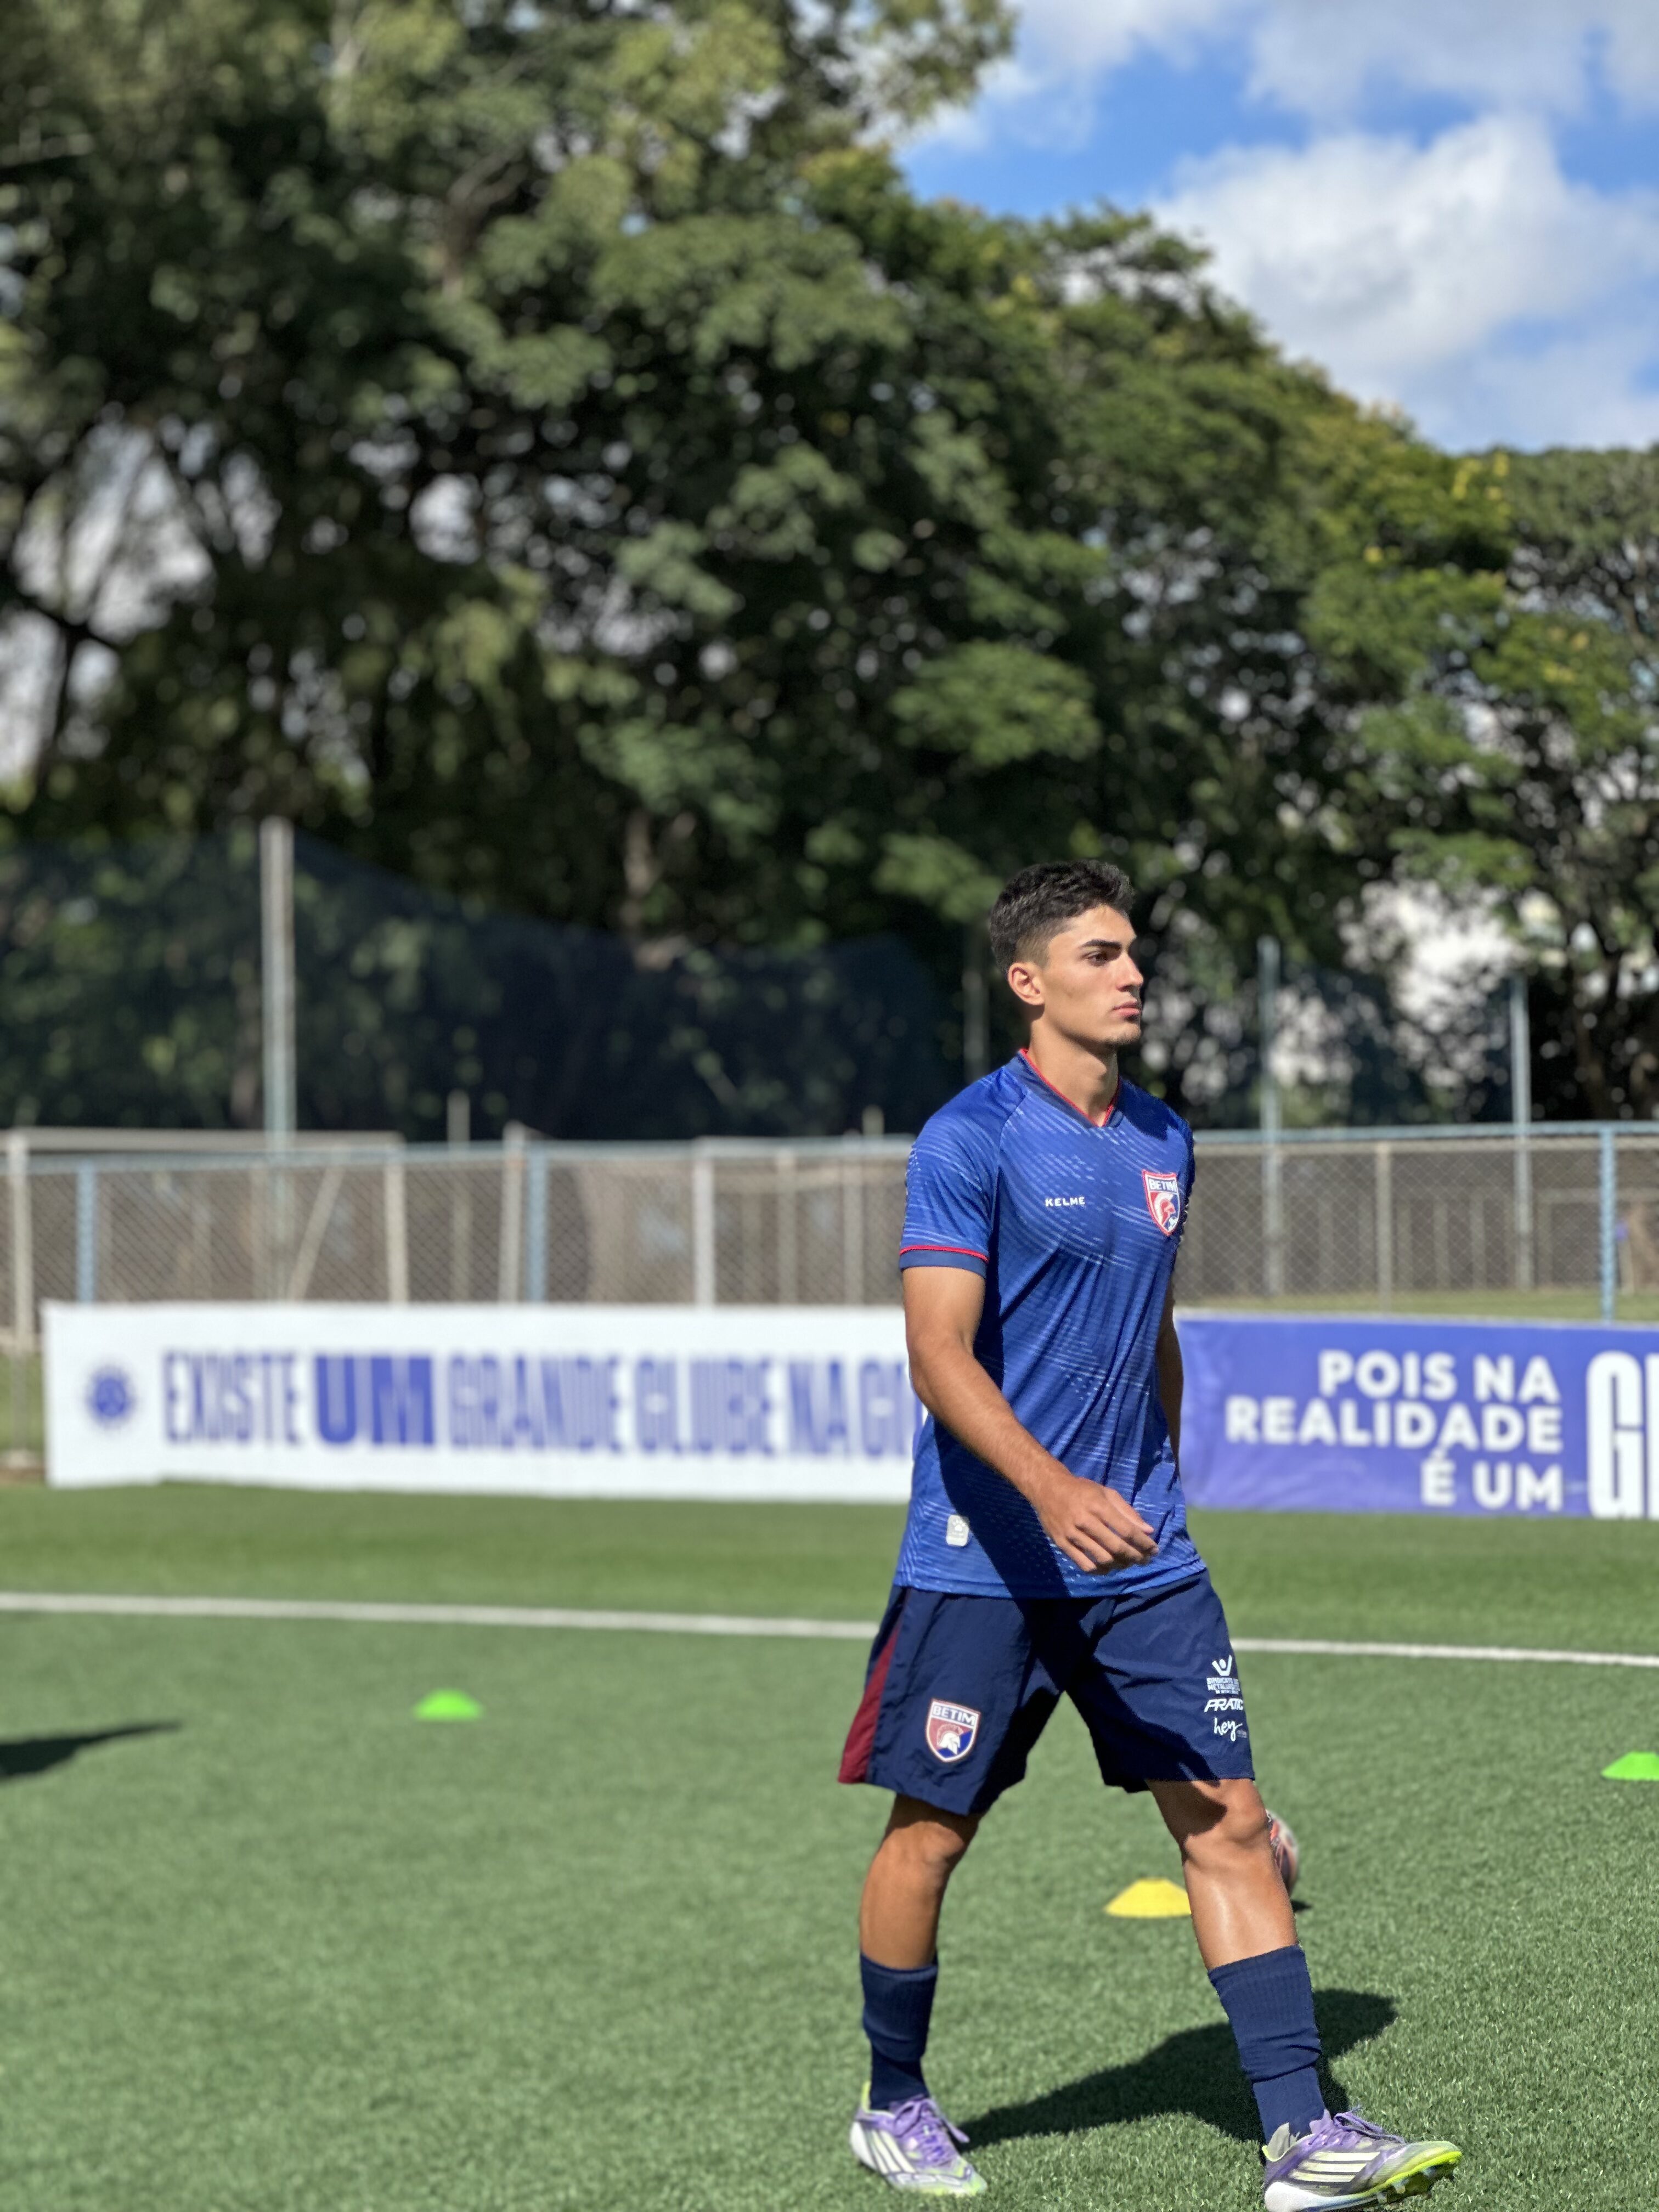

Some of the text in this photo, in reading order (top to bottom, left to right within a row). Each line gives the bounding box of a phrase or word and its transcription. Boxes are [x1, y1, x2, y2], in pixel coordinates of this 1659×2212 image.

[1045, 1197, 1086, 1207] KELME
[1148, 1178, 1177, 1192] BETIM
[315, 1355, 435, 1446] UM
[1318, 1349, 1560, 1404] POIS NA
[1226, 1396, 1562, 1453] REALIDADE
[1586, 1350, 1659, 1520] G
[1421, 1447, 1562, 1512] É UM
[933, 1706, 975, 1725] BETIM
[1214, 1717, 1243, 1742] hey
